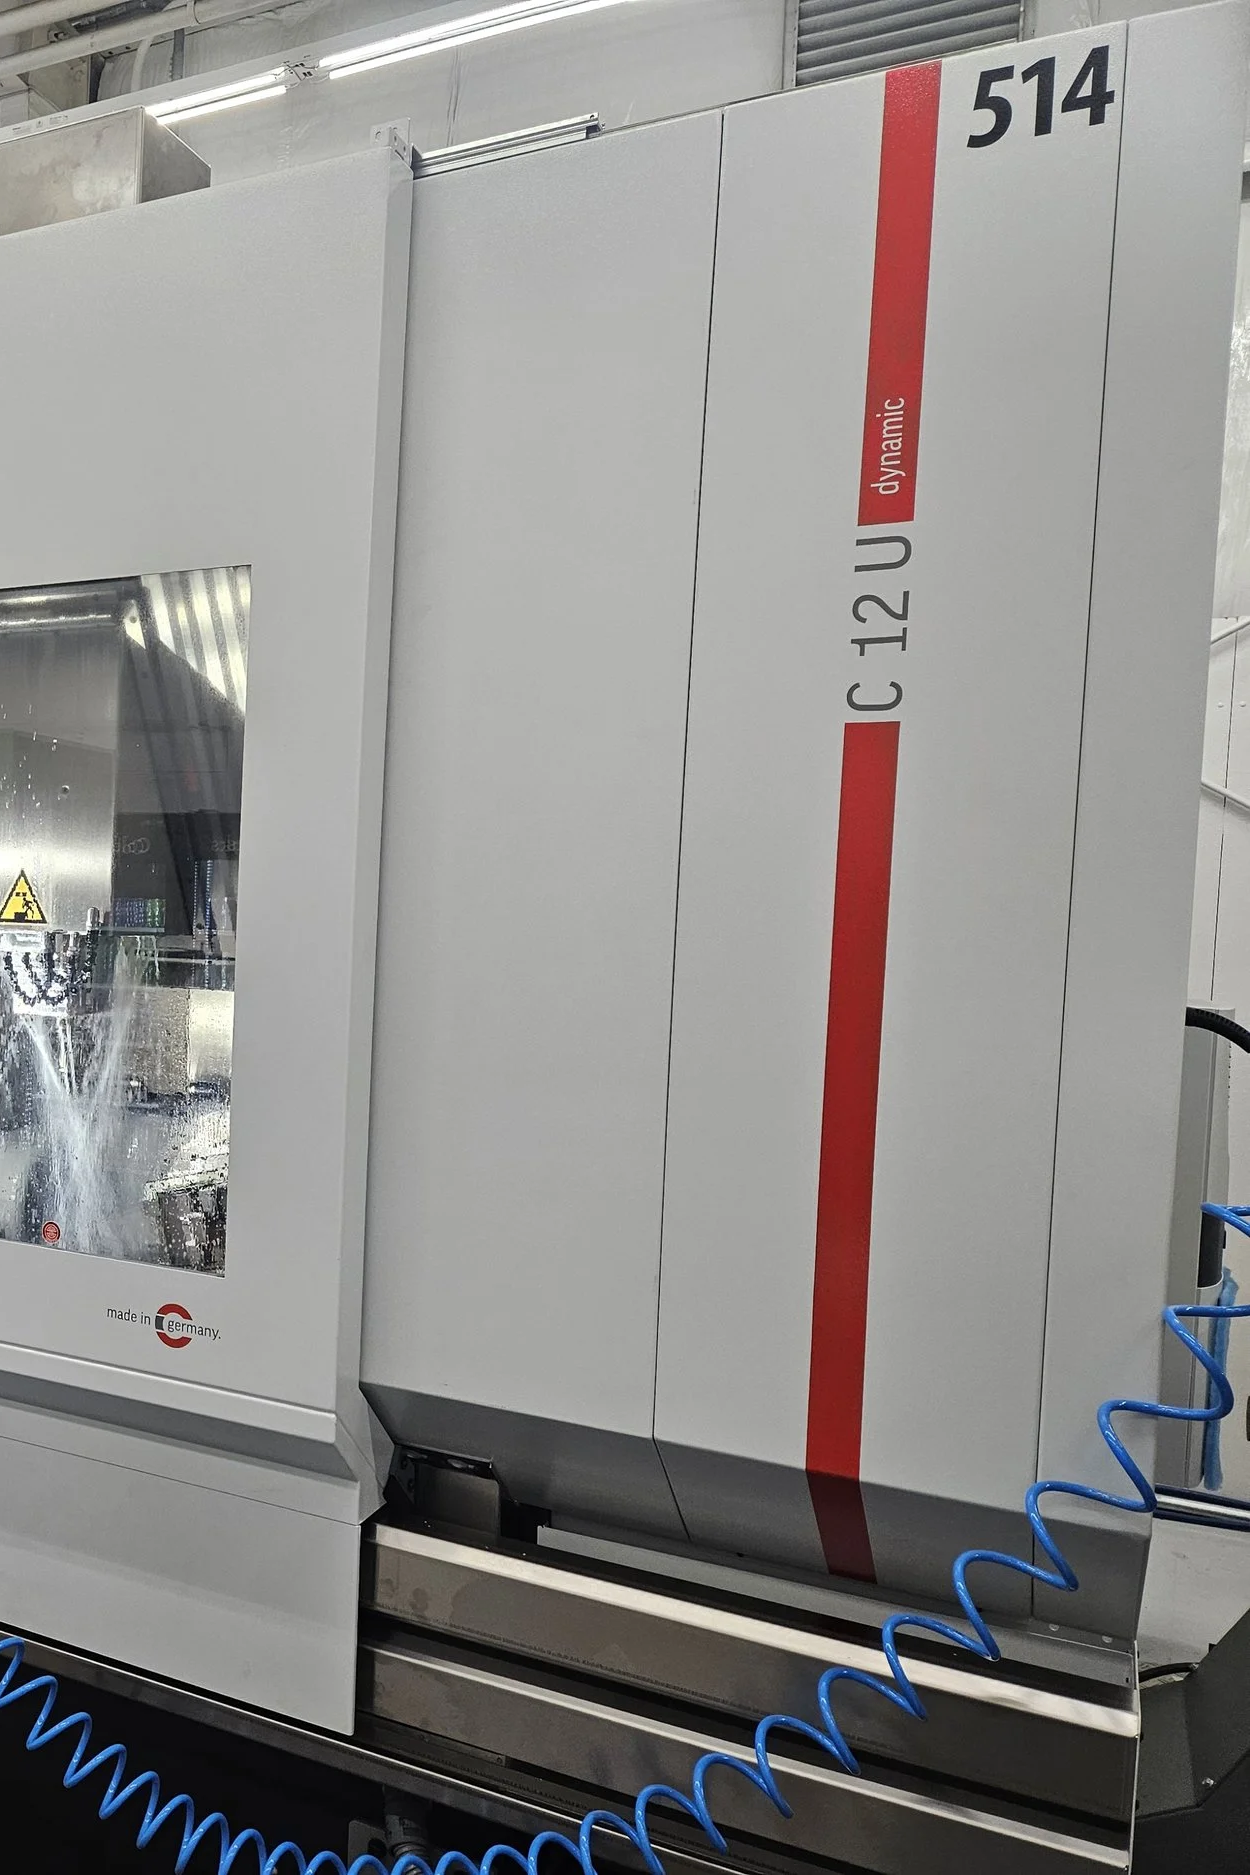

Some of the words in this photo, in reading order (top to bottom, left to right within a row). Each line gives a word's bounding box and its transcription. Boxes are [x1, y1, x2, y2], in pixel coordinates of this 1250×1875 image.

[966, 44, 1115, 149] 514
[870, 397, 906, 495] dynamic
[854, 535, 912, 573] U
[850, 590, 910, 657] 12
[846, 681, 903, 712] C
[106, 1307, 138, 1323] made
[140, 1311, 152, 1326] in
[167, 1319, 222, 1341] germany.
